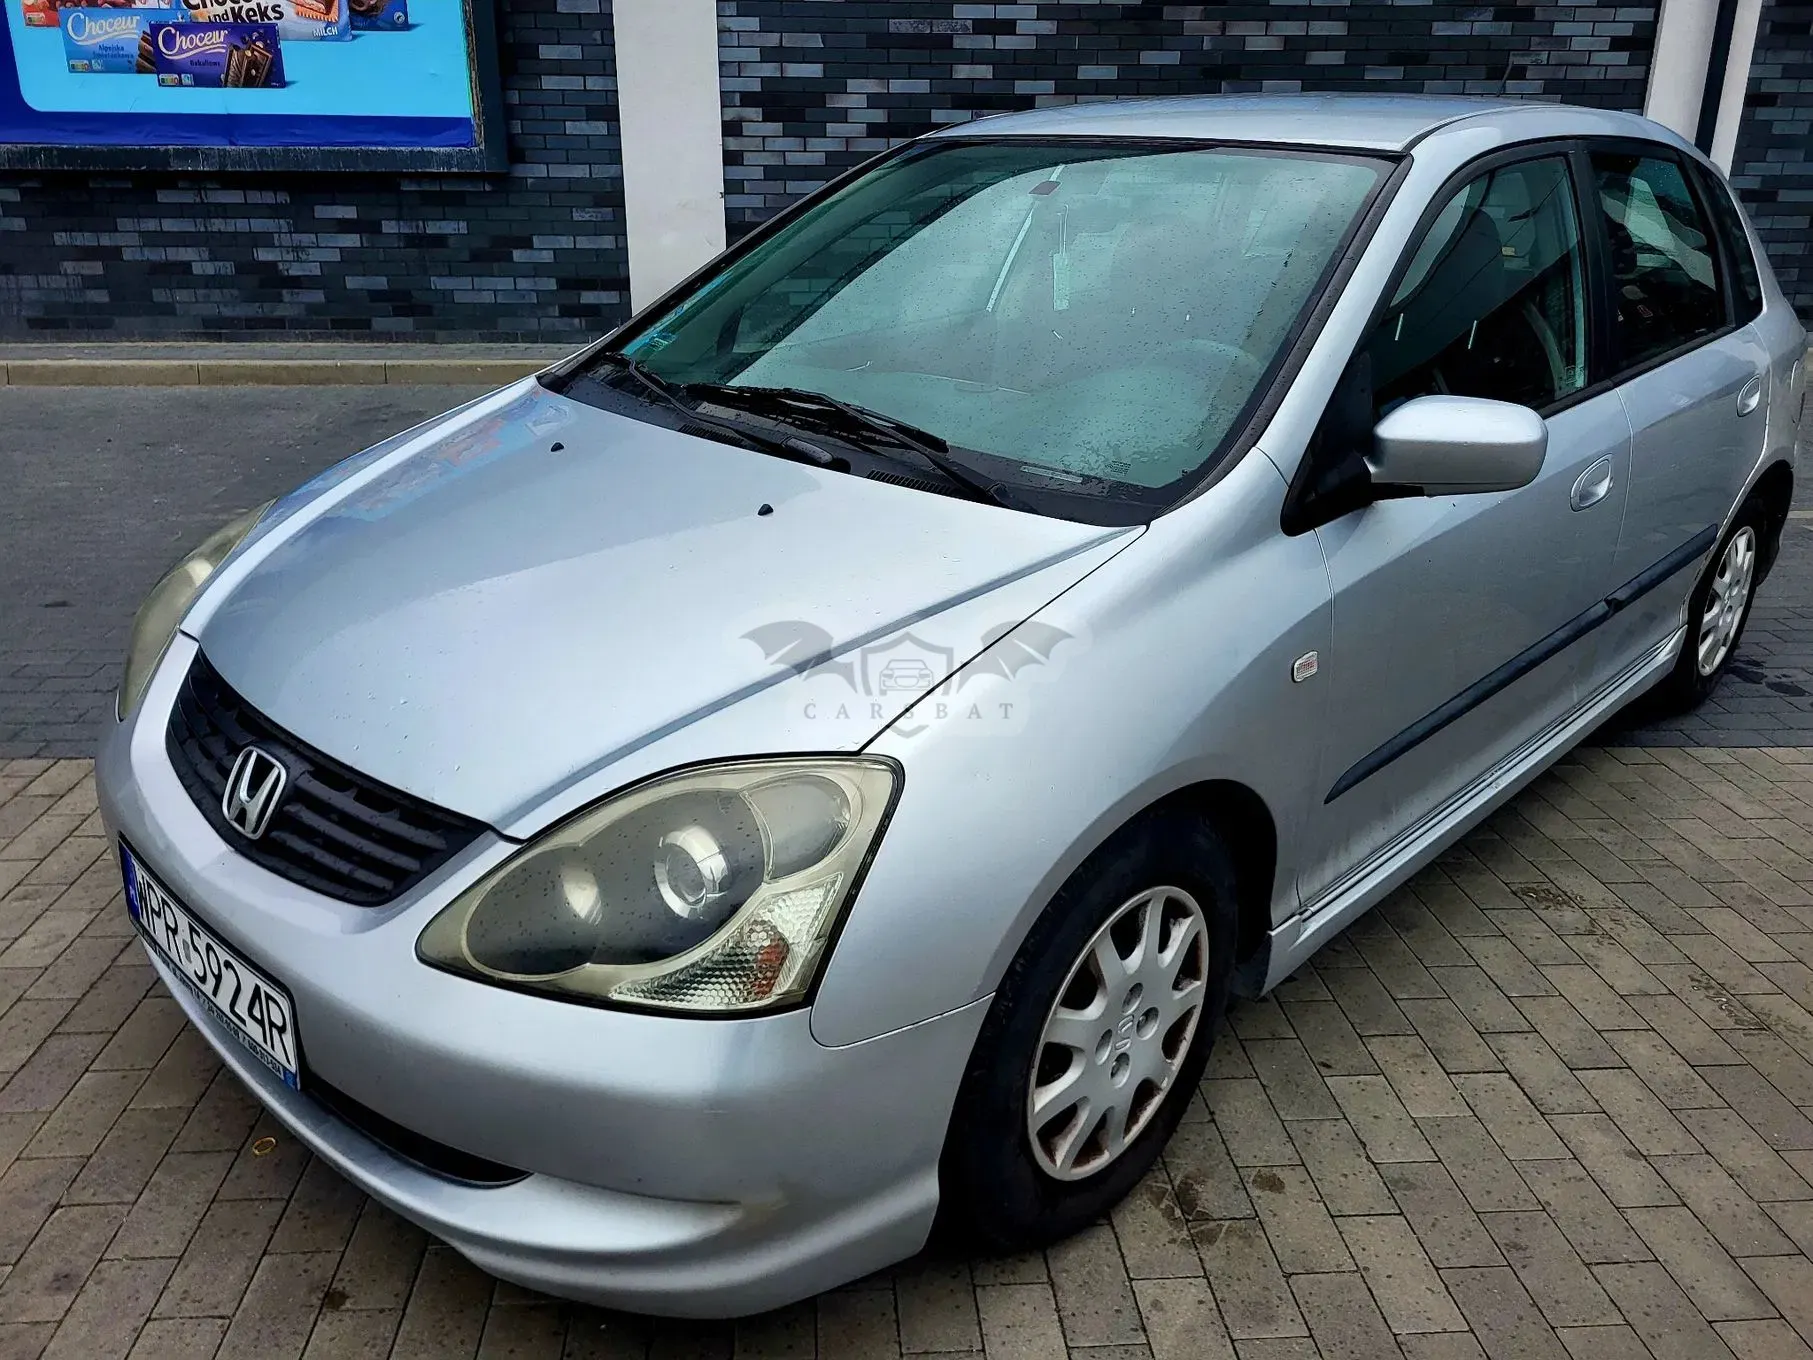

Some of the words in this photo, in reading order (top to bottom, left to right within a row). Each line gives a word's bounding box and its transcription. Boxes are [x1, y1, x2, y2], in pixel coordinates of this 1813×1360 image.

[231, 2, 284, 23] Keks
[67, 12, 140, 41] Choceur
[313, 27, 338, 37] MILCH
[158, 27, 228, 54] Choceur
[187, 920, 292, 1067] 5924R
